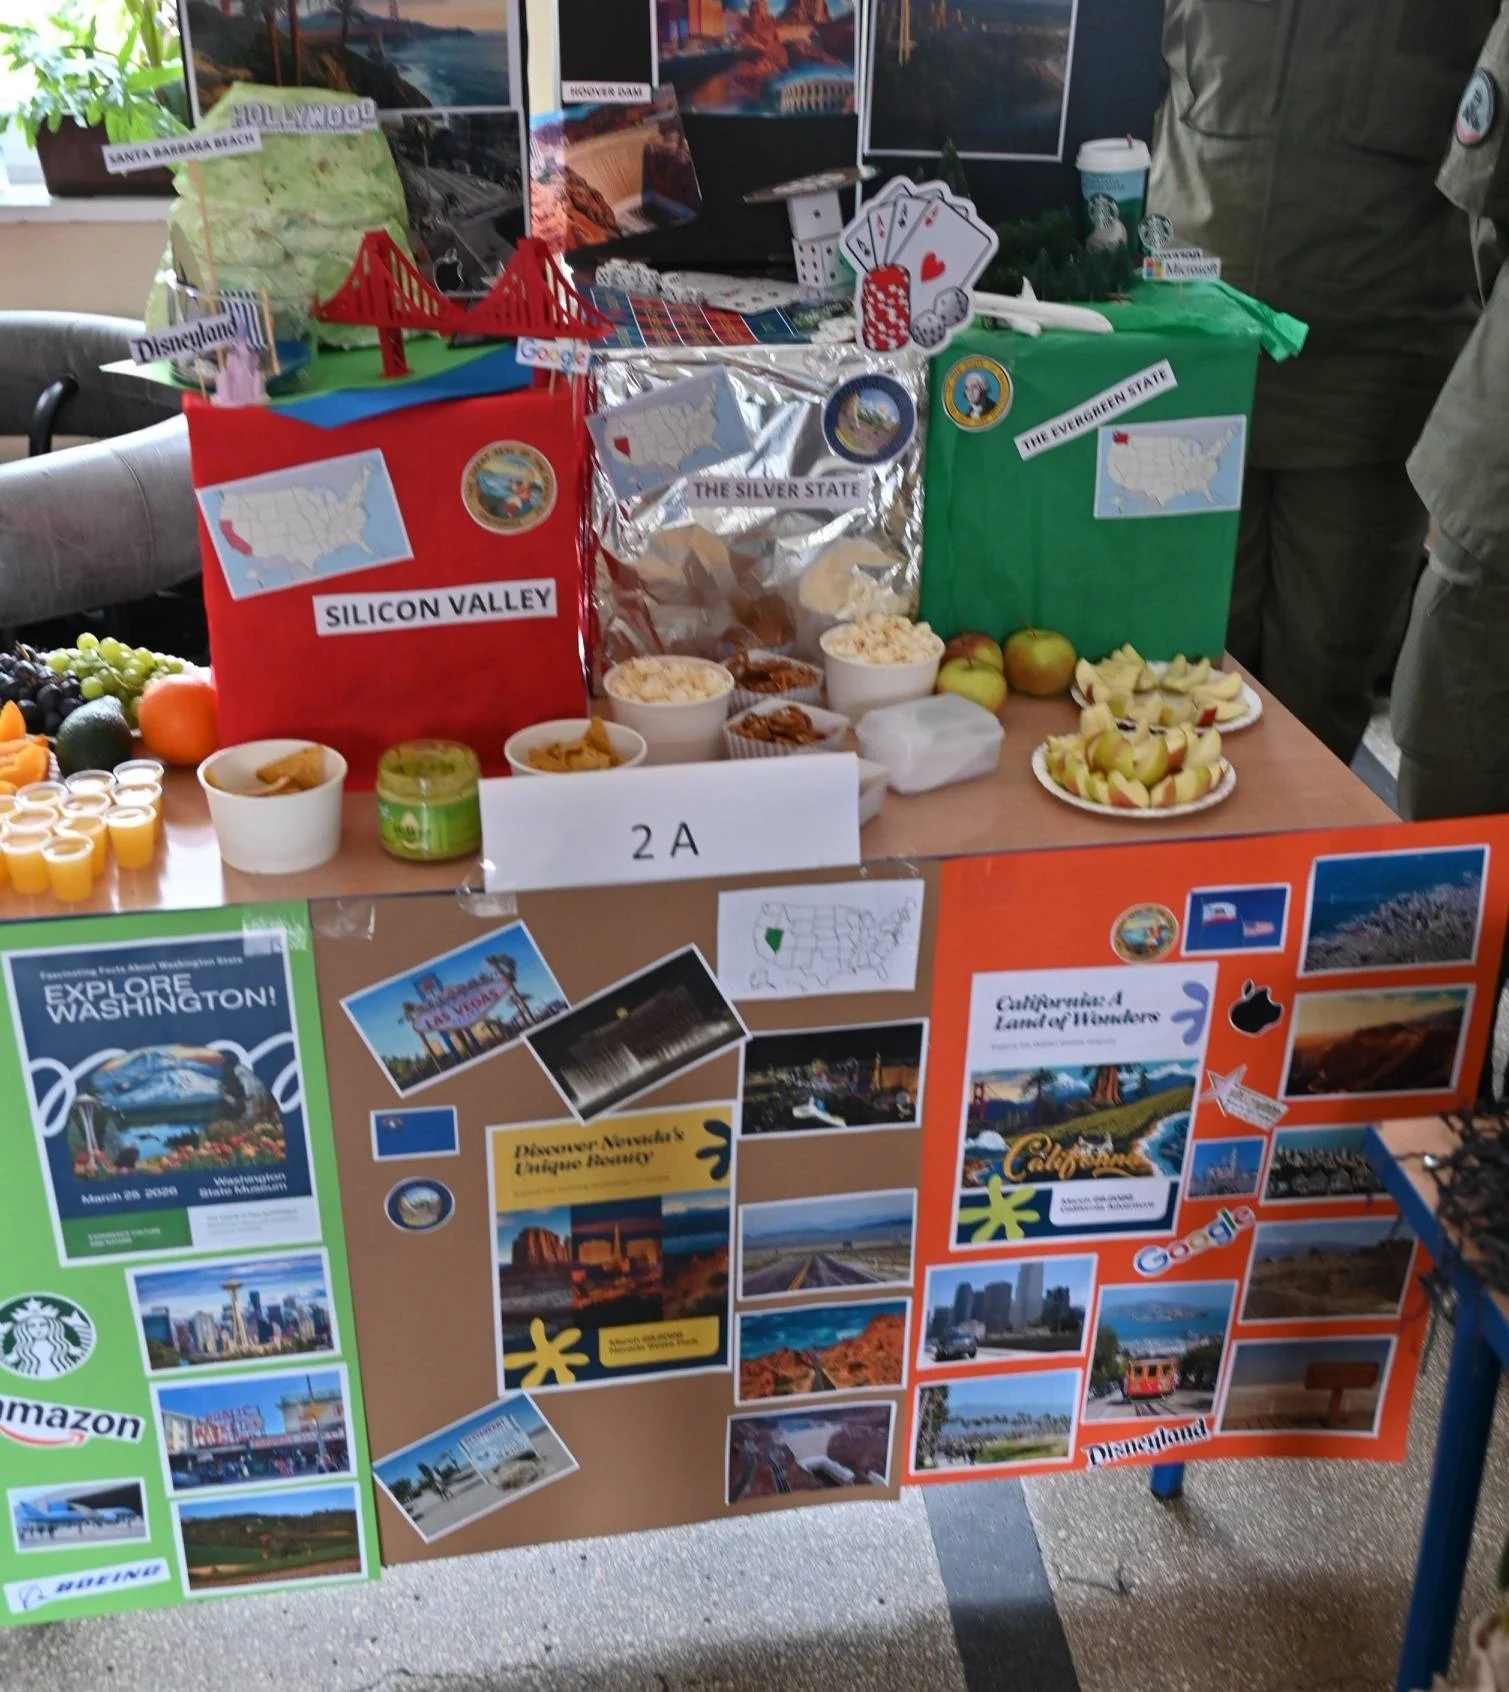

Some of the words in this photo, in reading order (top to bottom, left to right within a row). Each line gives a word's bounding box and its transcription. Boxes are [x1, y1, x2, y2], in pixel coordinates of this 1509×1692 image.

[570, 85, 615, 97] HOOVER
[231, 100, 375, 131] HOLLYWOOD
[108, 150, 151, 165] SANTA
[154, 140, 212, 160] BARBARA
[215, 133, 255, 149] BEACH
[1165, 262, 1218, 276] Microsoft
[132, 314, 238, 363] Disneyland
[520, 338, 586, 374] Google
[1022, 432, 1049, 452] THE
[1051, 392, 1127, 438] EVERGREEN
[1128, 367, 1169, 398] STATE
[692, 481, 730, 498] THE
[735, 481, 799, 499] SILVER
[804, 481, 861, 499] STATE
[325, 597, 440, 628] SILICON
[448, 586, 551, 616] VALLEY
[631, 823, 655, 860] 2
[670, 820, 699, 858] A
[128, 960, 157, 973] About
[158, 956, 216, 970] Washington
[44, 972, 194, 1006] EXPLORE
[453, 989, 501, 1016] VEGAS
[46, 985, 277, 1025] WASHINGTON!
[994, 1013, 1047, 1031] Land
[1048, 1011, 1072, 1031] of
[1072, 1008, 1161, 1028] Wonders
[513, 1138, 598, 1160] Discover
[601, 1126, 685, 1151] Nevada's
[514, 1157, 582, 1177] Unique
[586, 1149, 654, 1169] Beauty
[199, 1186, 233, 1199] State
[213, 1171, 287, 1187] Washington
[81, 1189, 122, 1204] March
[1136, 1207, 1254, 1273] Google
[0, 1399, 141, 1439] mazon
[1082, 1417, 1208, 1466] Disneyland
[56, 1564, 162, 1593] BOEING
